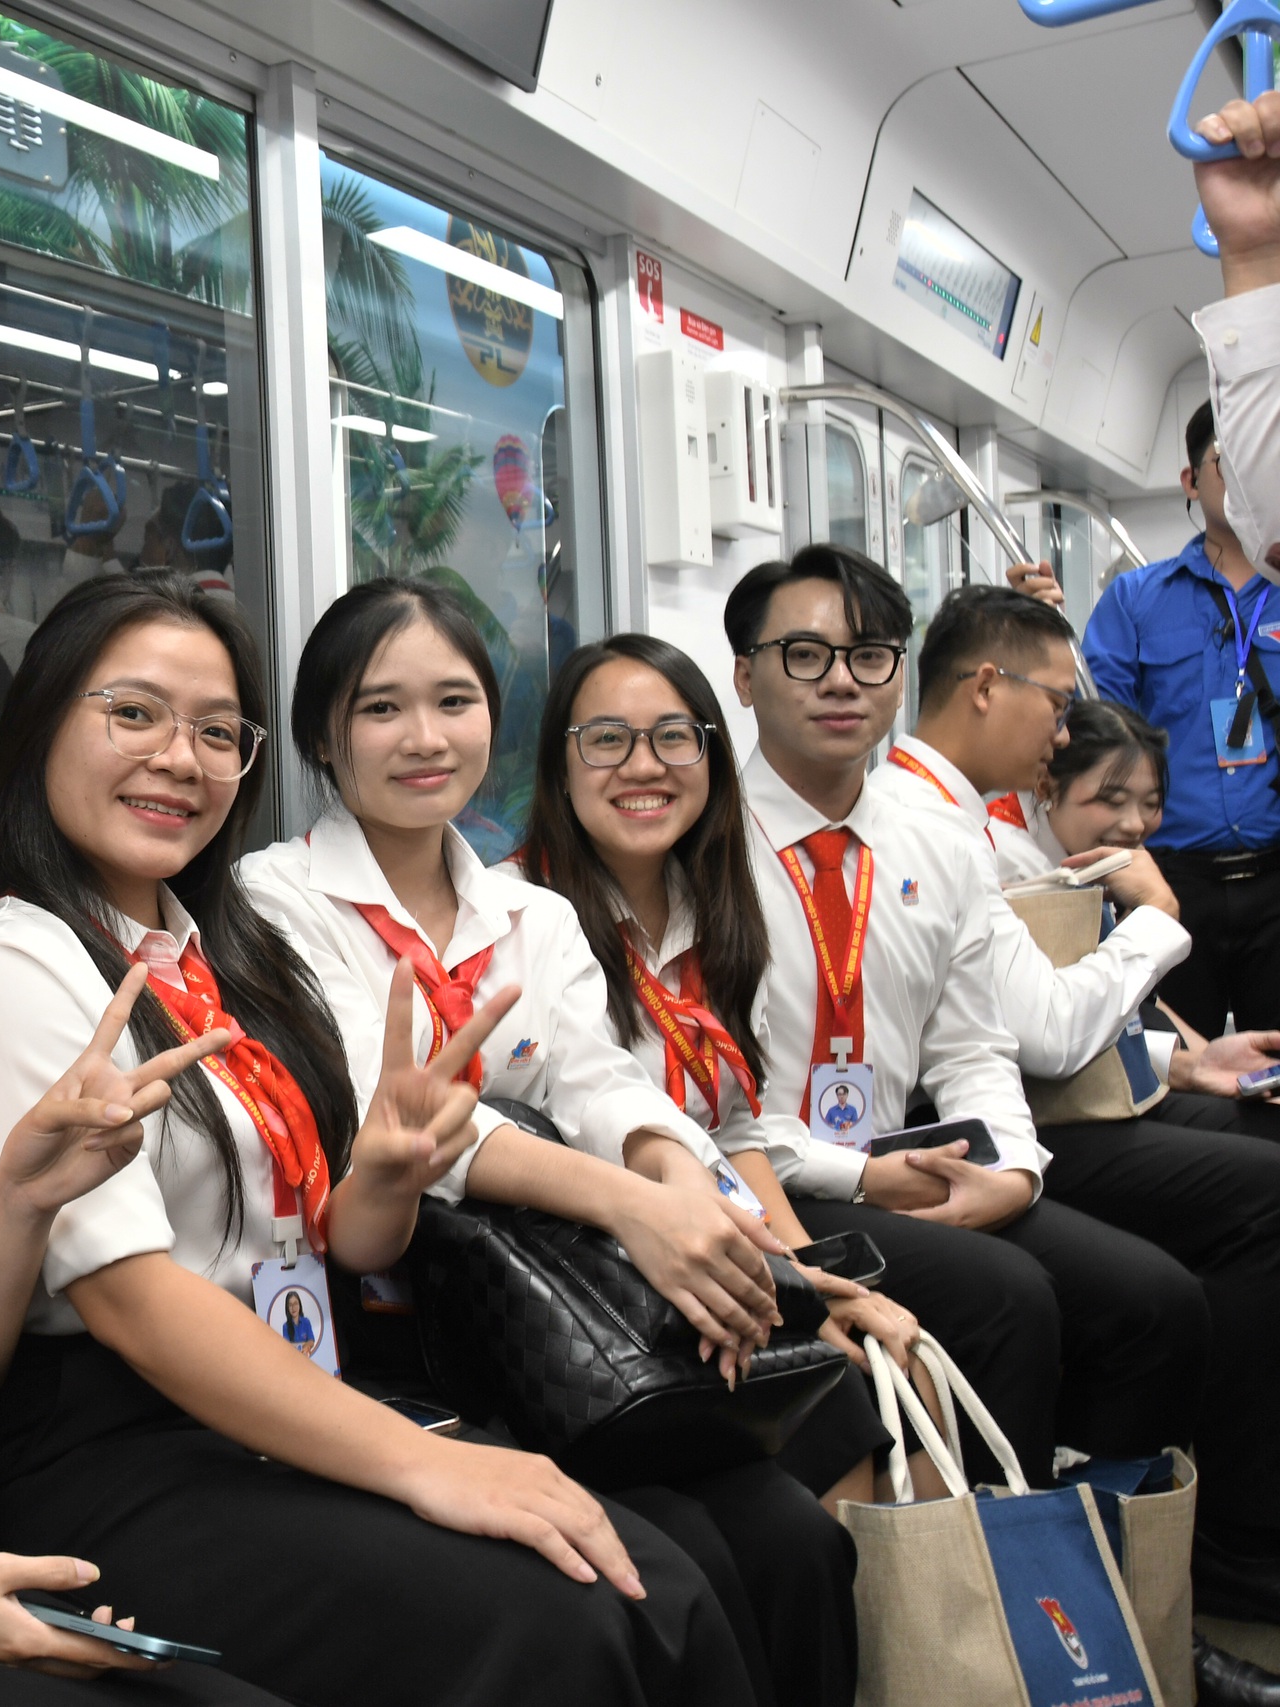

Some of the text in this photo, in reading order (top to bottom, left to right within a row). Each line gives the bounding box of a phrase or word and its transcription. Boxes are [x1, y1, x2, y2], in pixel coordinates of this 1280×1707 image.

[639, 255, 660, 281] SOS
[858, 902, 866, 916] OF
[855, 915, 865, 930] HO
[851, 930, 861, 947] CHI
[842, 973, 854, 996] CITY
[202, 1009, 215, 1035] HCYU
[671, 1031, 695, 1063] THANH
[714, 1039, 738, 1053] HCMC
[204, 1055, 265, 1126] HO CHI MINH
